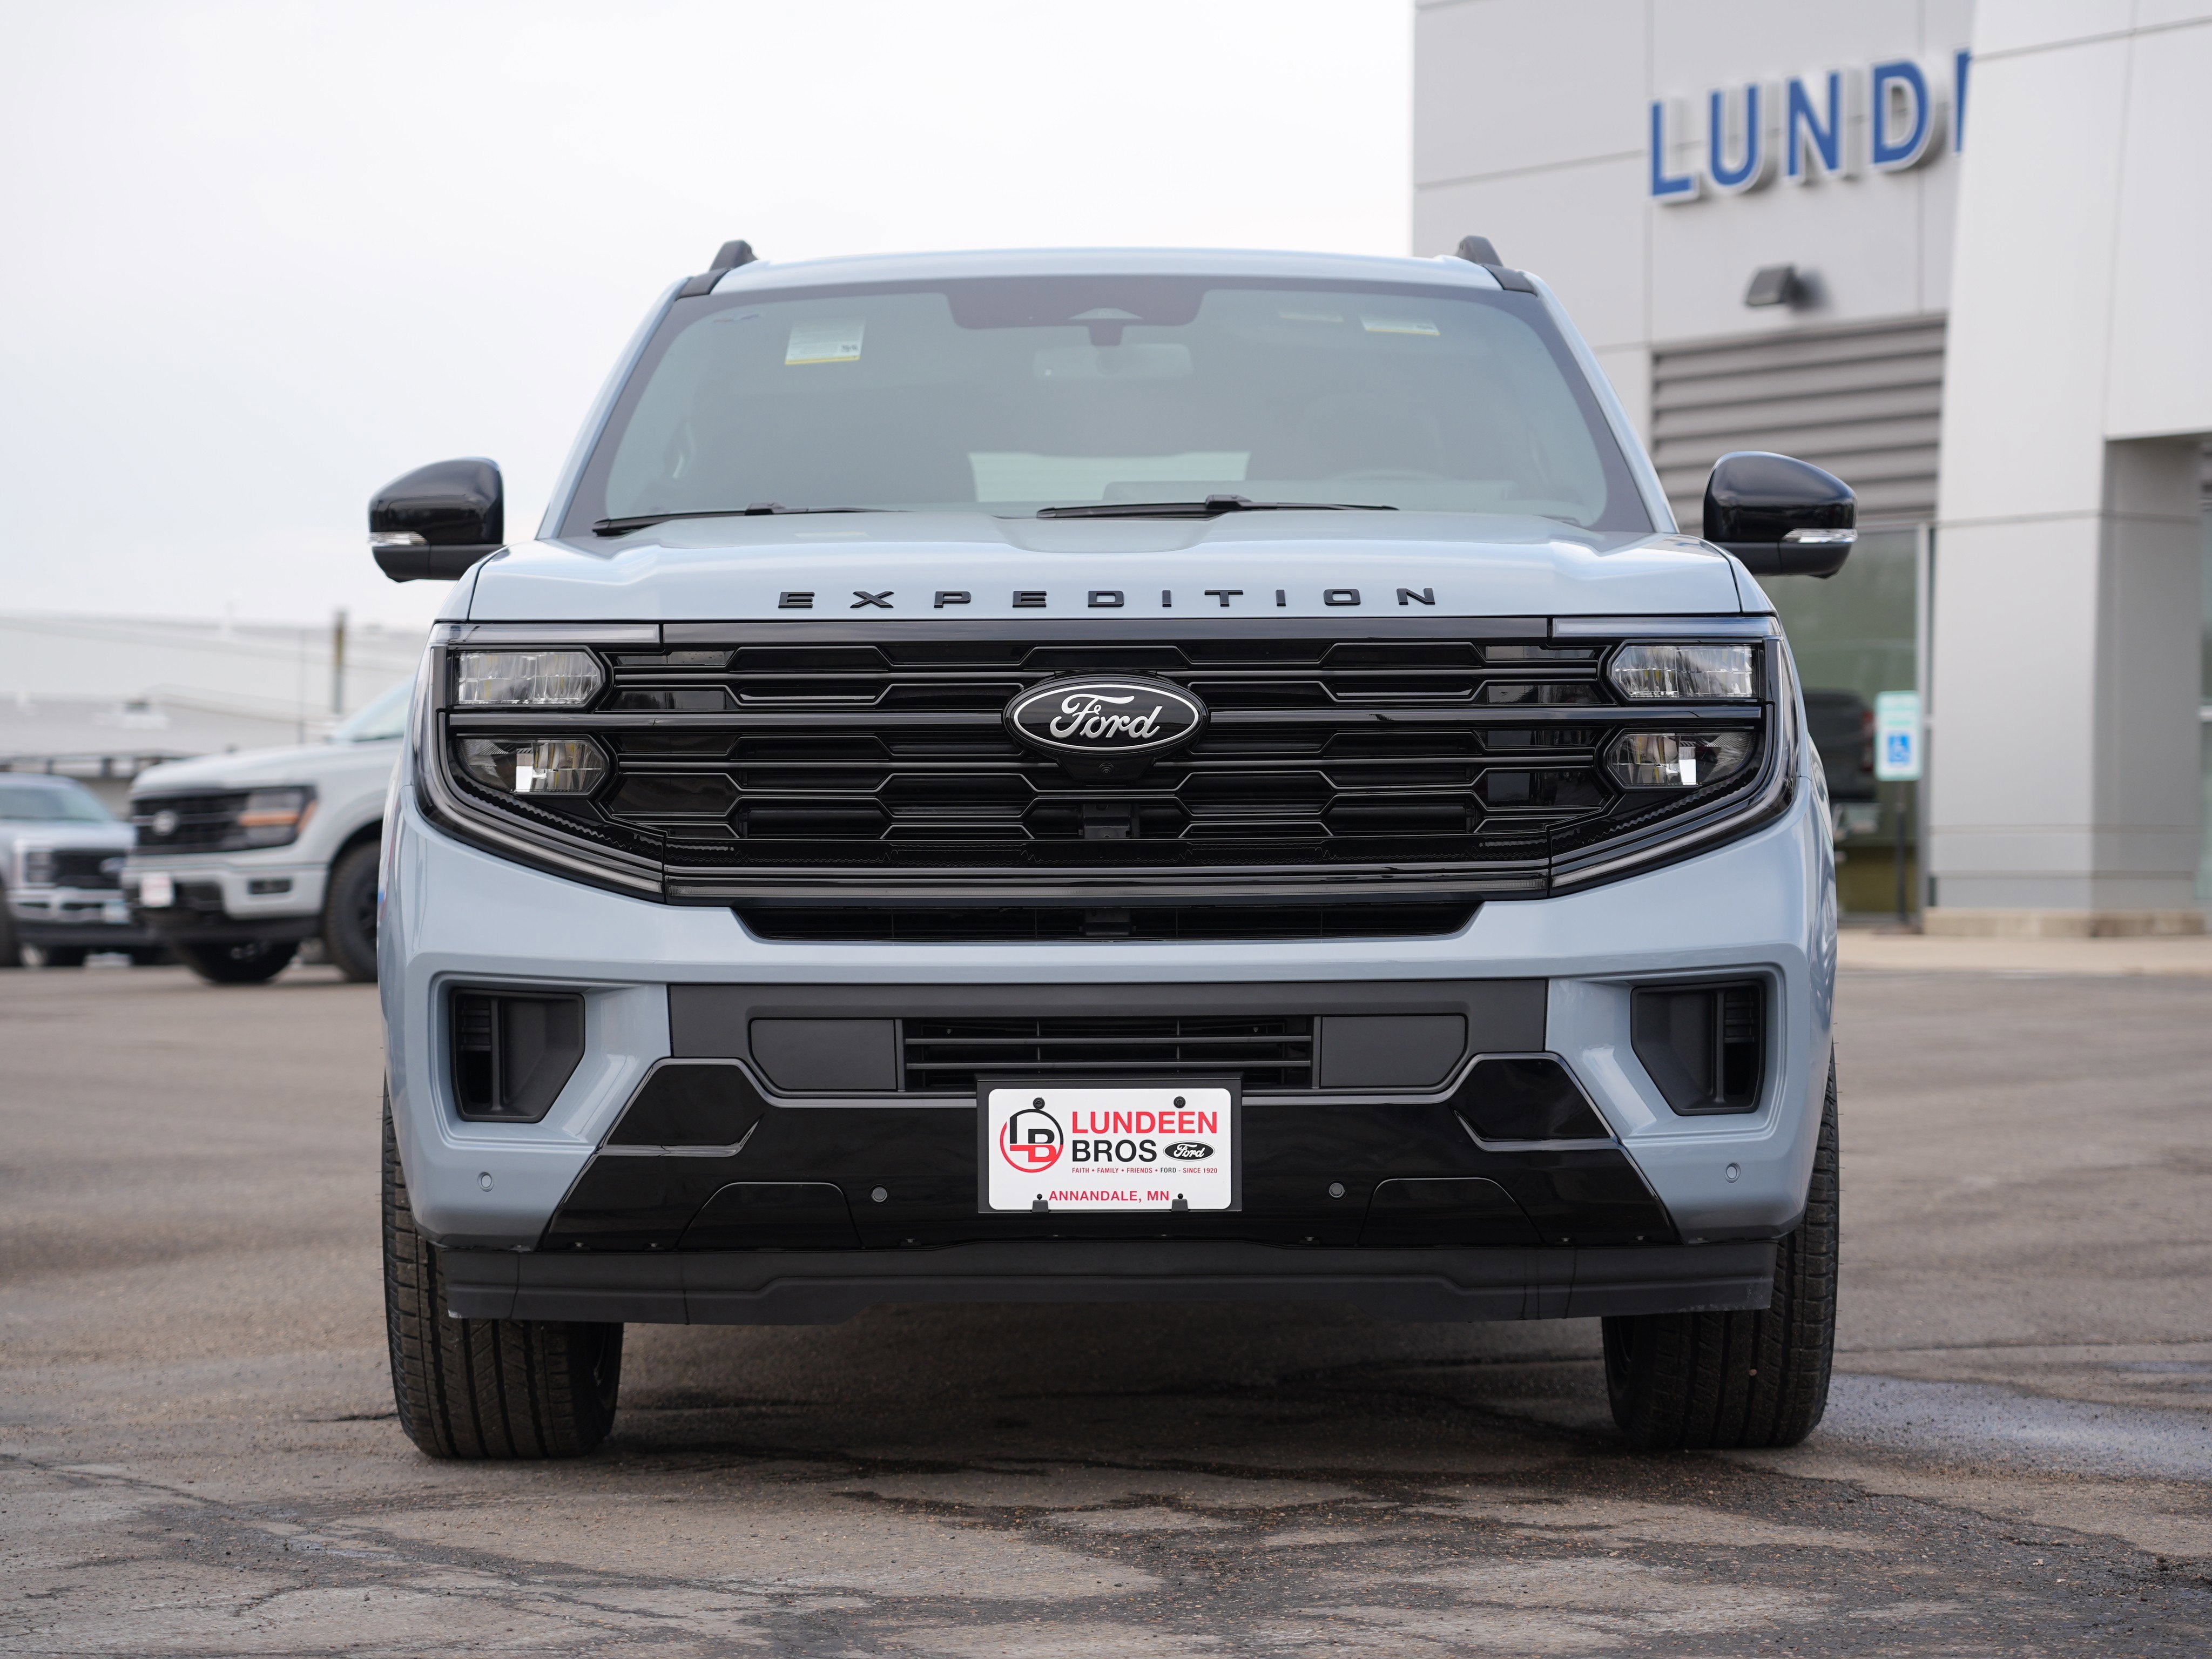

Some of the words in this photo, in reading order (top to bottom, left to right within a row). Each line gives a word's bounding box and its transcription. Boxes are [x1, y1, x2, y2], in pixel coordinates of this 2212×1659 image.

[778, 588, 1437, 609] EXPEDITION
[1049, 693, 1163, 739] Ford
[1072, 1111, 1217, 1134] LUNDEEN
[1072, 1139, 1157, 1163] BROS
[1174, 1143, 1205, 1157] Ford
[1049, 1190, 1142, 1203] ANNANDALE,
[1147, 1190, 1169, 1201] MN
